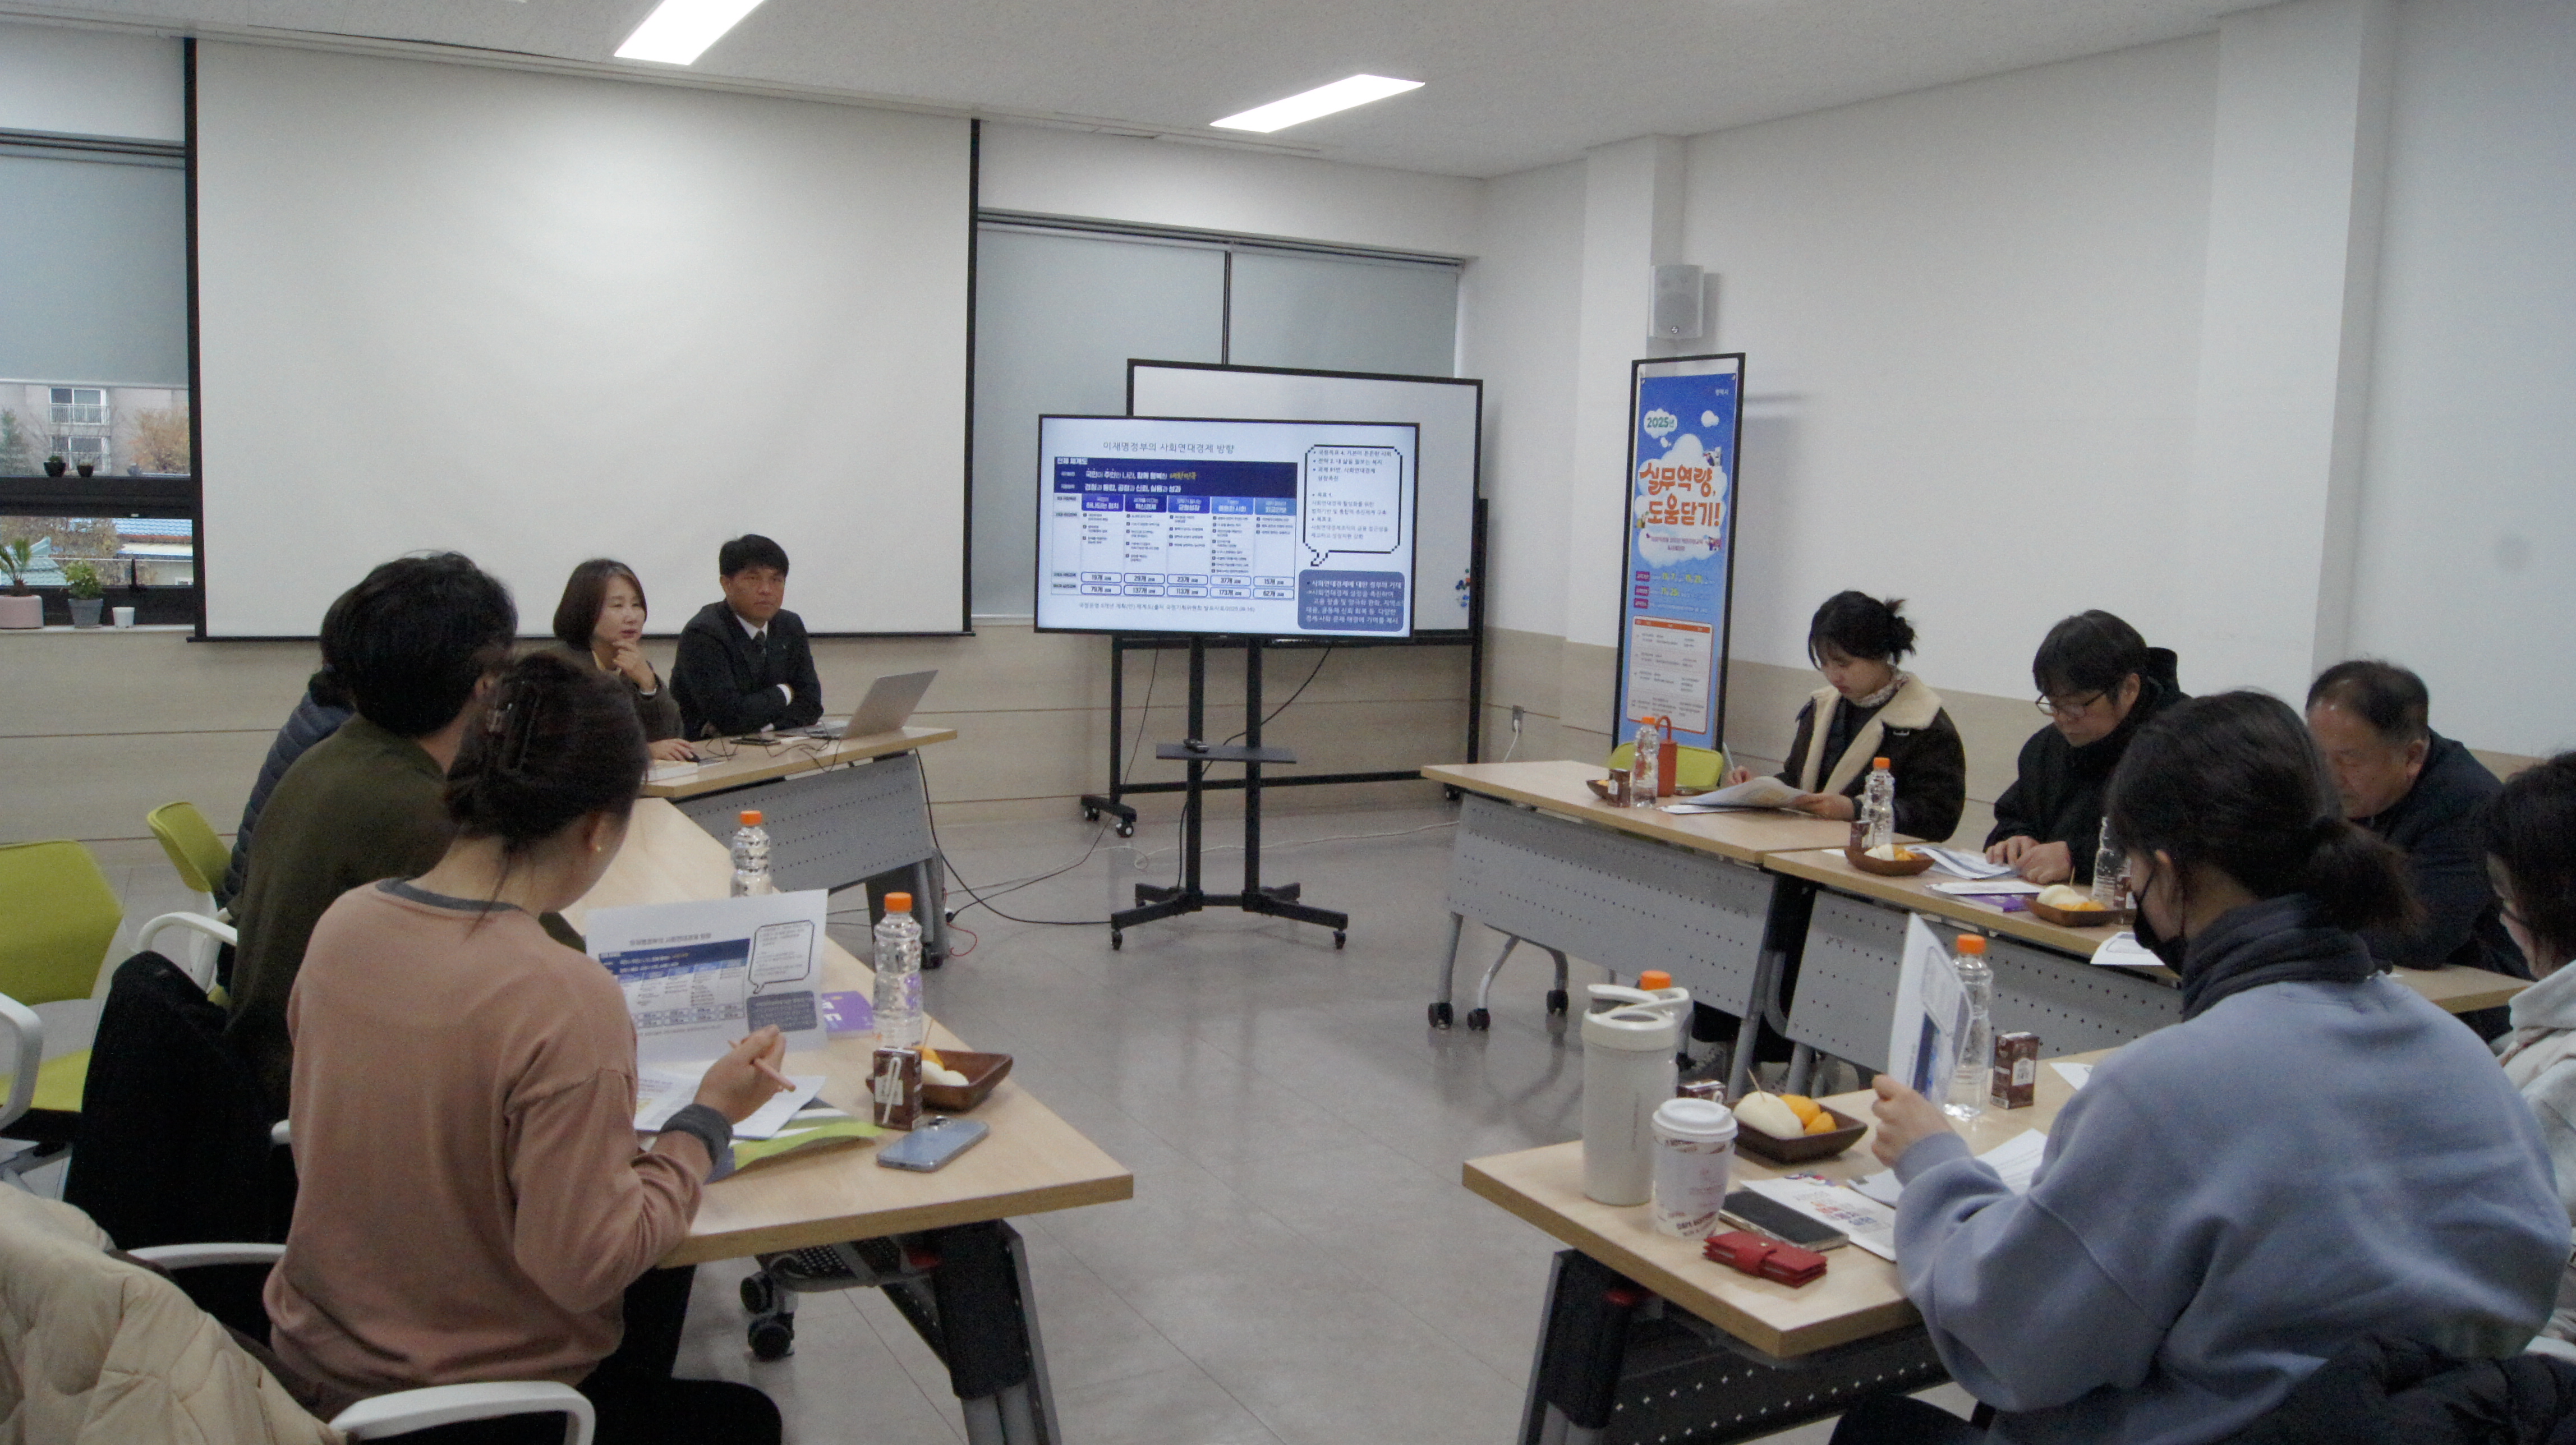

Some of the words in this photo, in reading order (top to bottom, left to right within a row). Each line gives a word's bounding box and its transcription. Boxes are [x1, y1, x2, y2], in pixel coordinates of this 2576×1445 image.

[1103, 442, 1157, 452] 이재명정부의
[1161, 443, 1213, 453] 사회연대경제
[1217, 444, 1234, 454] 방향
[1648, 493, 1721, 526] 도움닫기!
